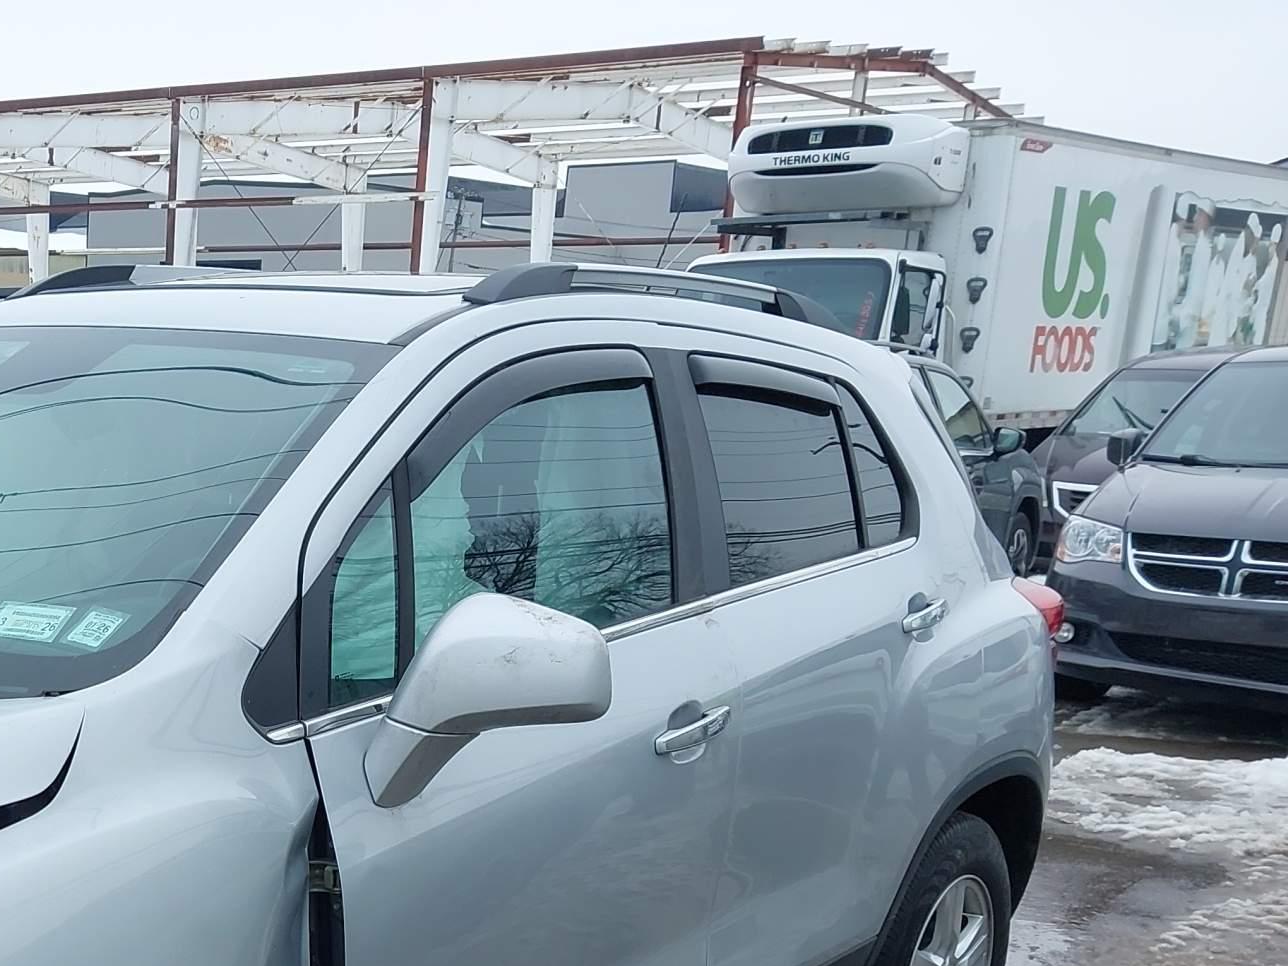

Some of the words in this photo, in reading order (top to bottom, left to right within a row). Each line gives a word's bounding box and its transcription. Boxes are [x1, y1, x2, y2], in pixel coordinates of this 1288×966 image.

[772, 153, 820, 166] THERMO
[822, 151, 851, 163] KING
[1029, 325, 1099, 374] FOODS
